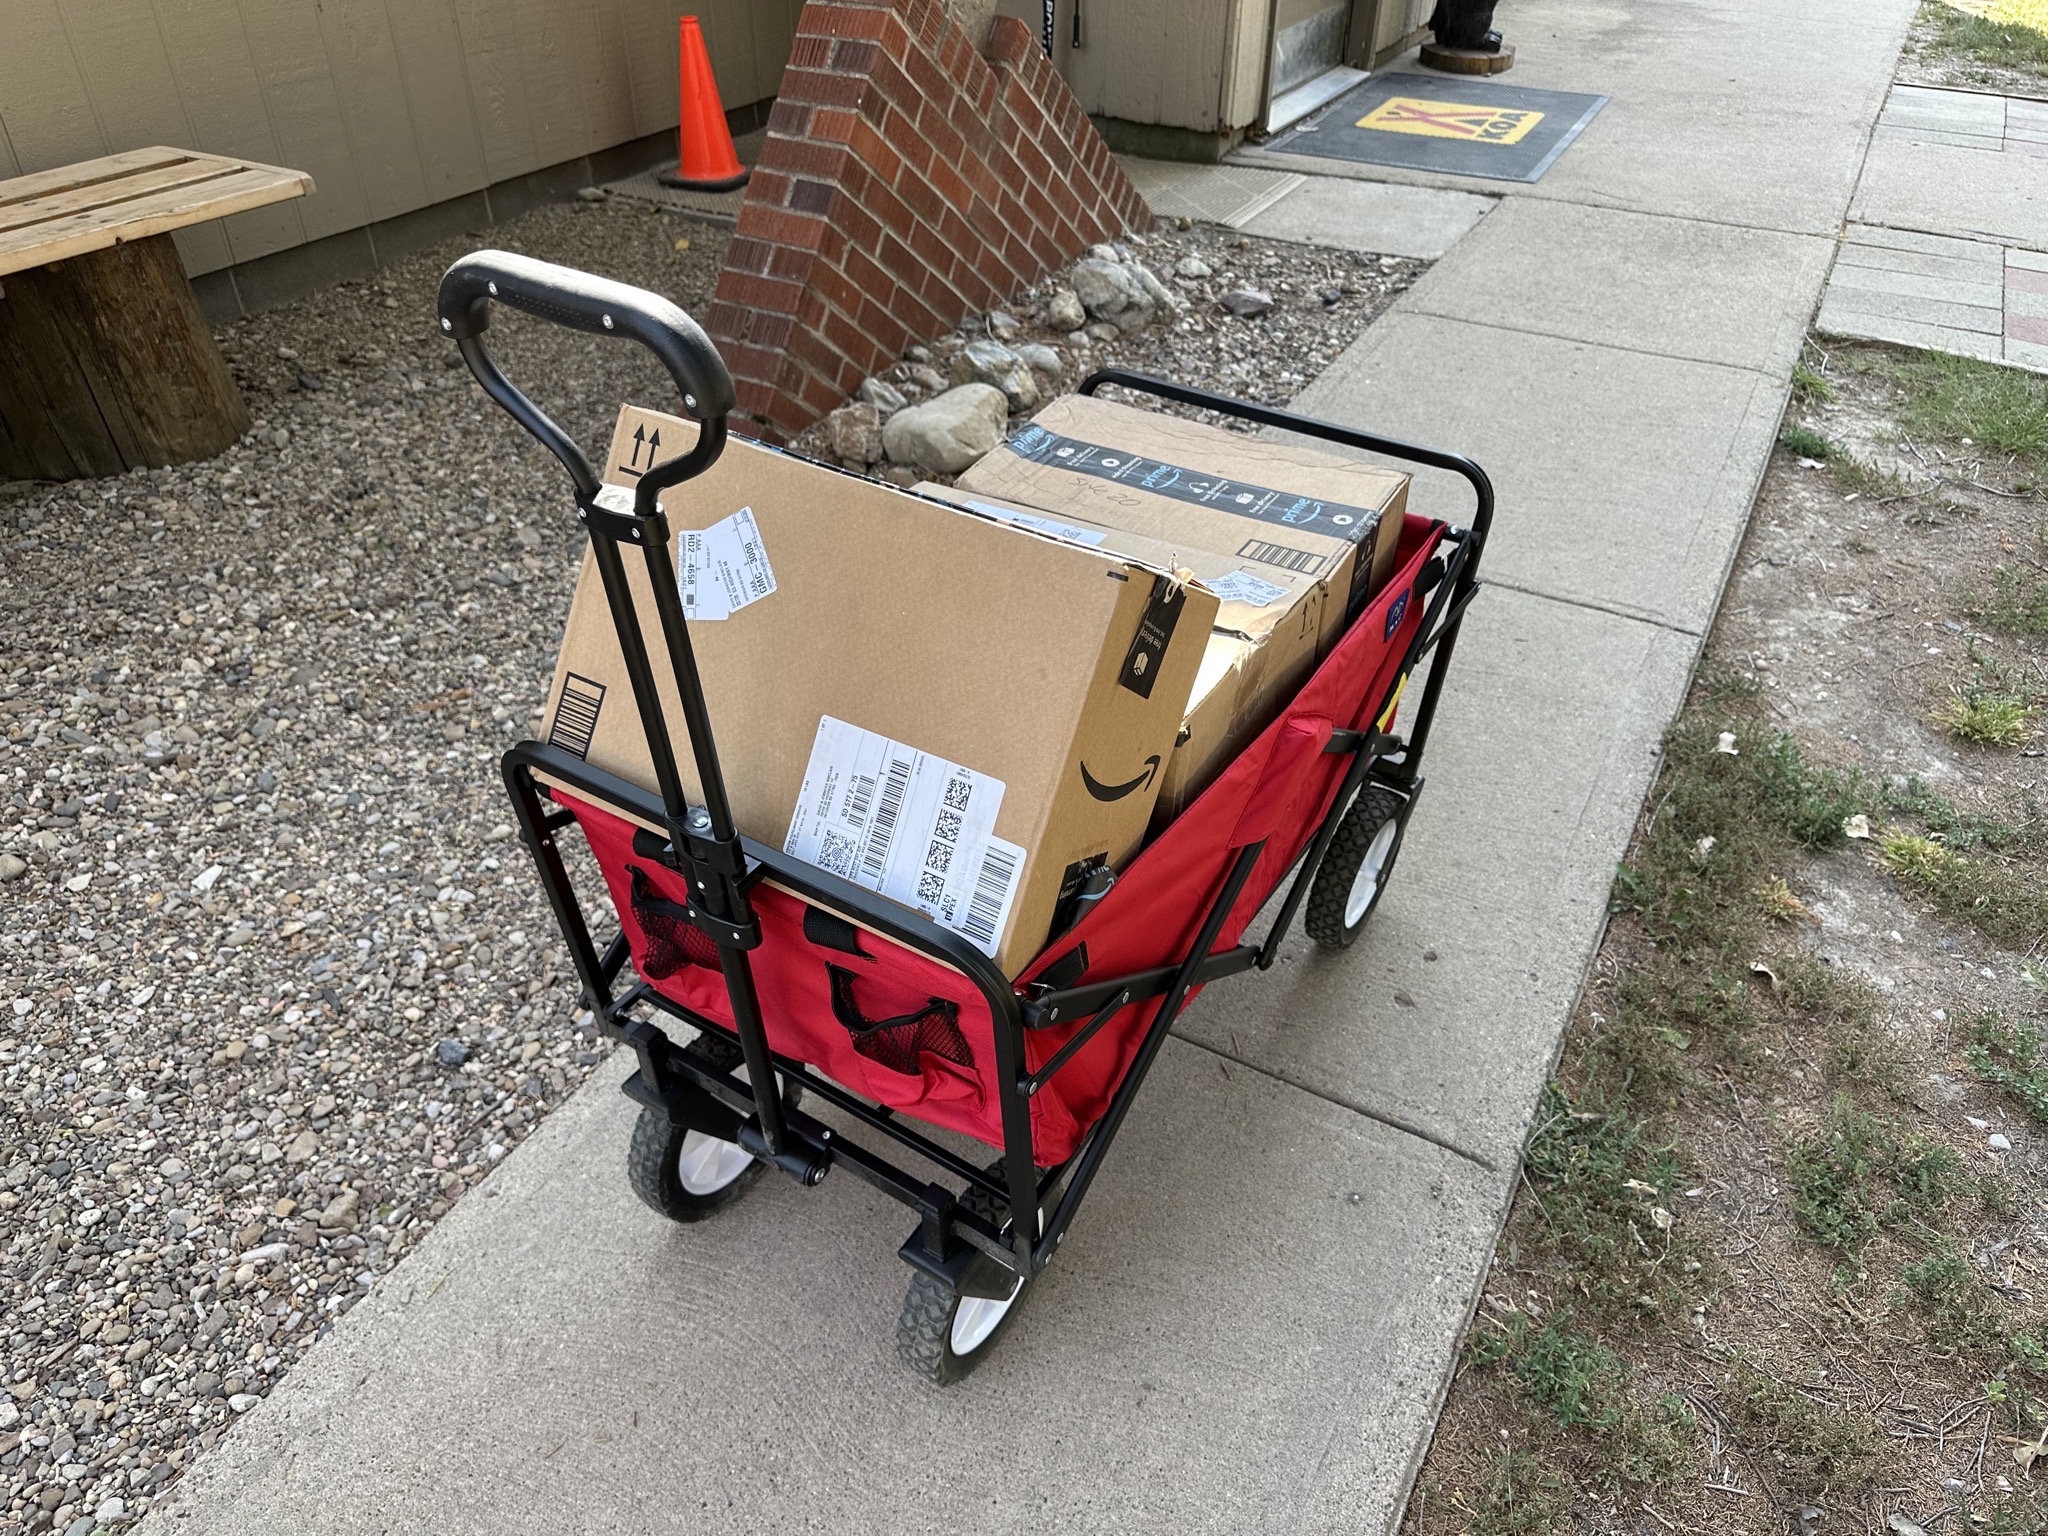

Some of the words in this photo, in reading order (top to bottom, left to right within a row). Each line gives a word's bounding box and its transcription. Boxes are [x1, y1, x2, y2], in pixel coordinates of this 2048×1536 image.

[1477, 113, 1529, 139] KOA
[1013, 427, 1043, 453] prime
[1141, 465, 1170, 488] prime
[1281, 498, 1310, 523] prime
[941, 894, 952, 912] SLC1
[949, 897, 957, 911] PEX
